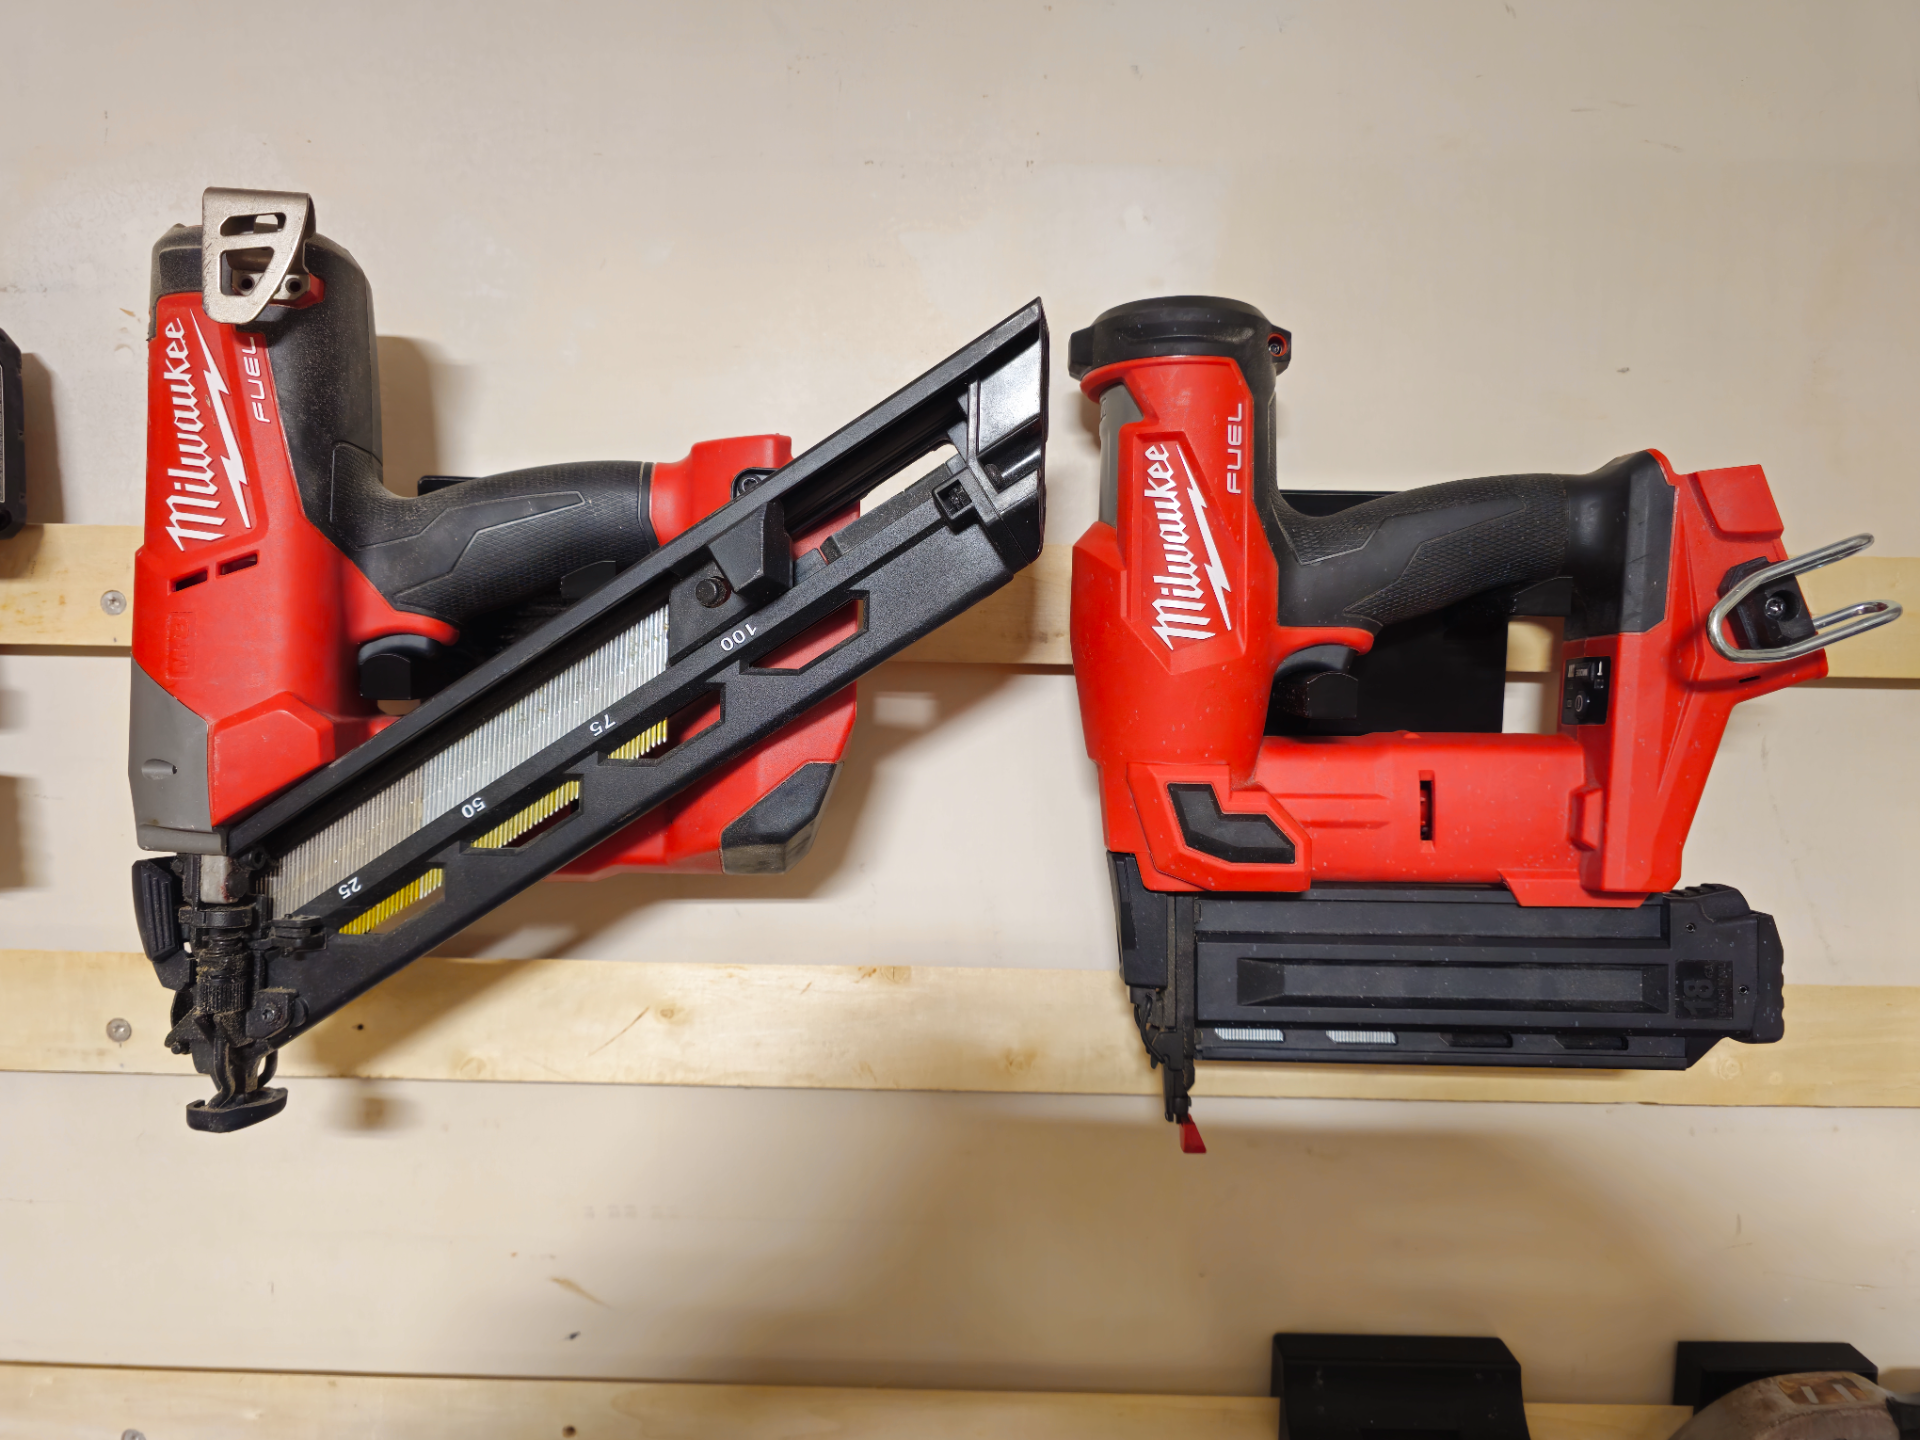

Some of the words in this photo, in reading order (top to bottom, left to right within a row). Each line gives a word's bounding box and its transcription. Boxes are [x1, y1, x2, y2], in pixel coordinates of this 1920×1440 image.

[242, 337, 271, 423] FUEL
[164, 318, 226, 552] Milwaukee
[1226, 403, 1243, 494] FUEL
[1143, 443, 1216, 650] Milwaukee
[720, 623, 757, 651] 100
[589, 713, 616, 737] 75
[461, 797, 487, 819] 50
[338, 876, 362, 900] 25
[1683, 979, 1715, 1015] 18
